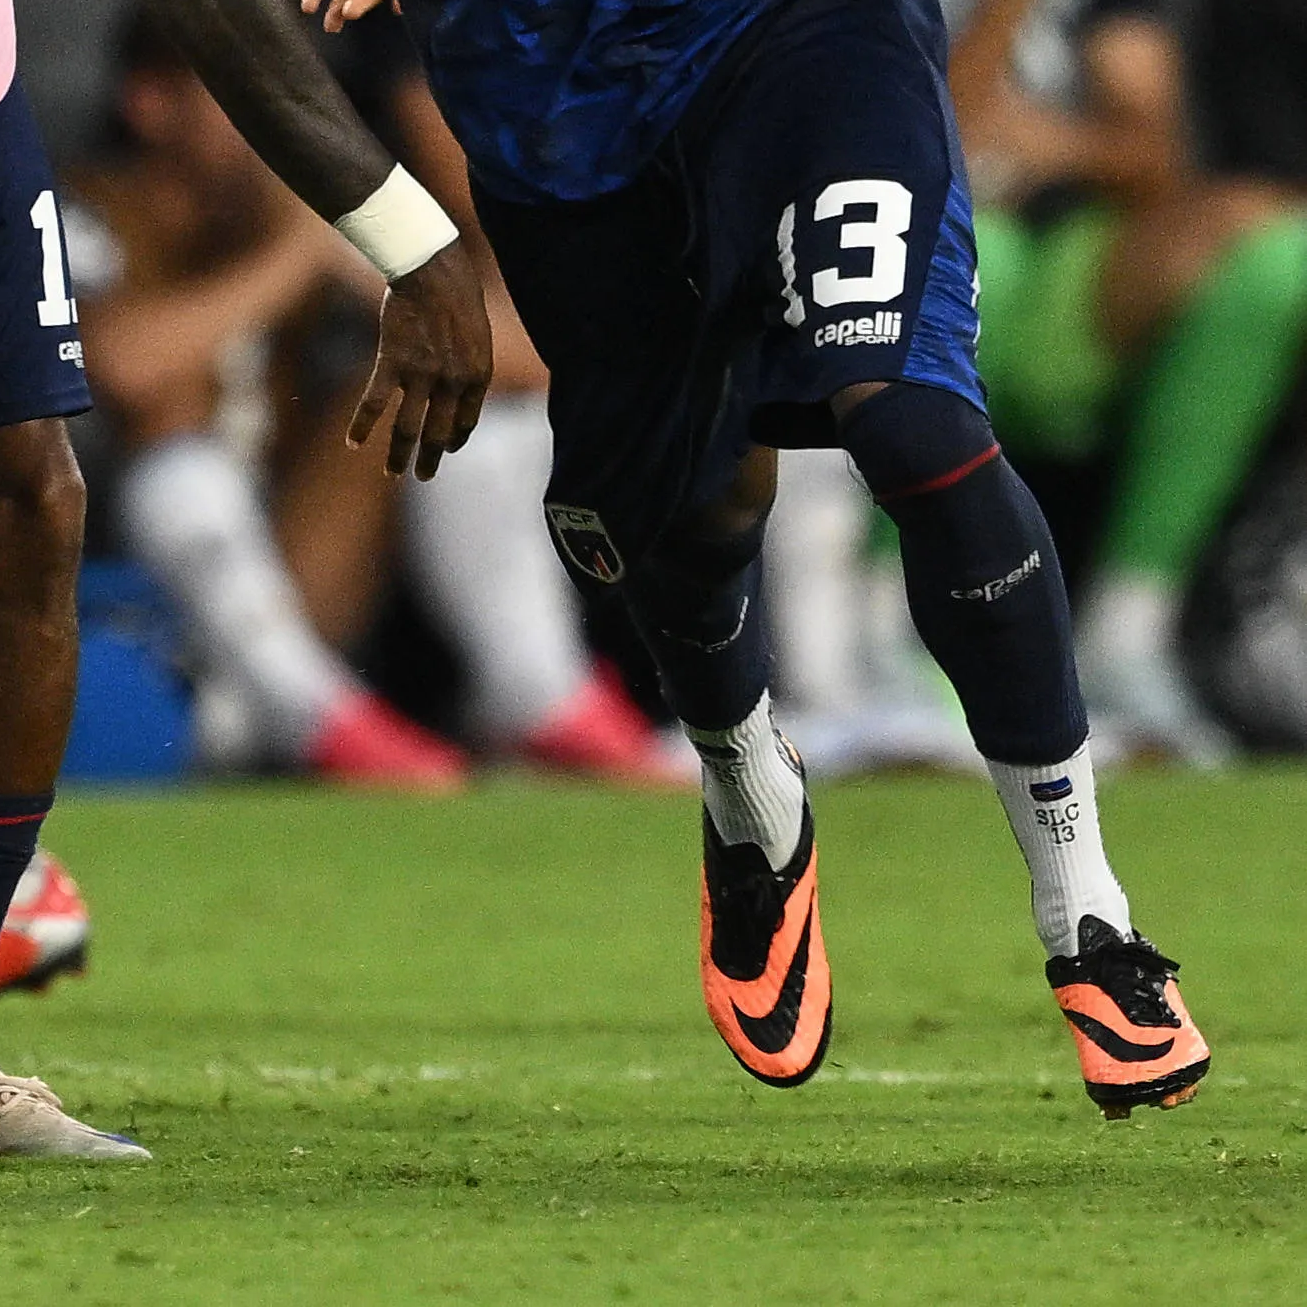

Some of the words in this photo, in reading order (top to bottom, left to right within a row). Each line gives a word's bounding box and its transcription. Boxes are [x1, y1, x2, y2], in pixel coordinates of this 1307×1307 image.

[30, 190, 79, 326] 1
[814, 311, 903, 348] capelli
[844, 336, 900, 346] SPORT
[950, 549, 1041, 602] capelli
[1035, 802, 1080, 826] SLC
[1050, 825, 1076, 845] 13
